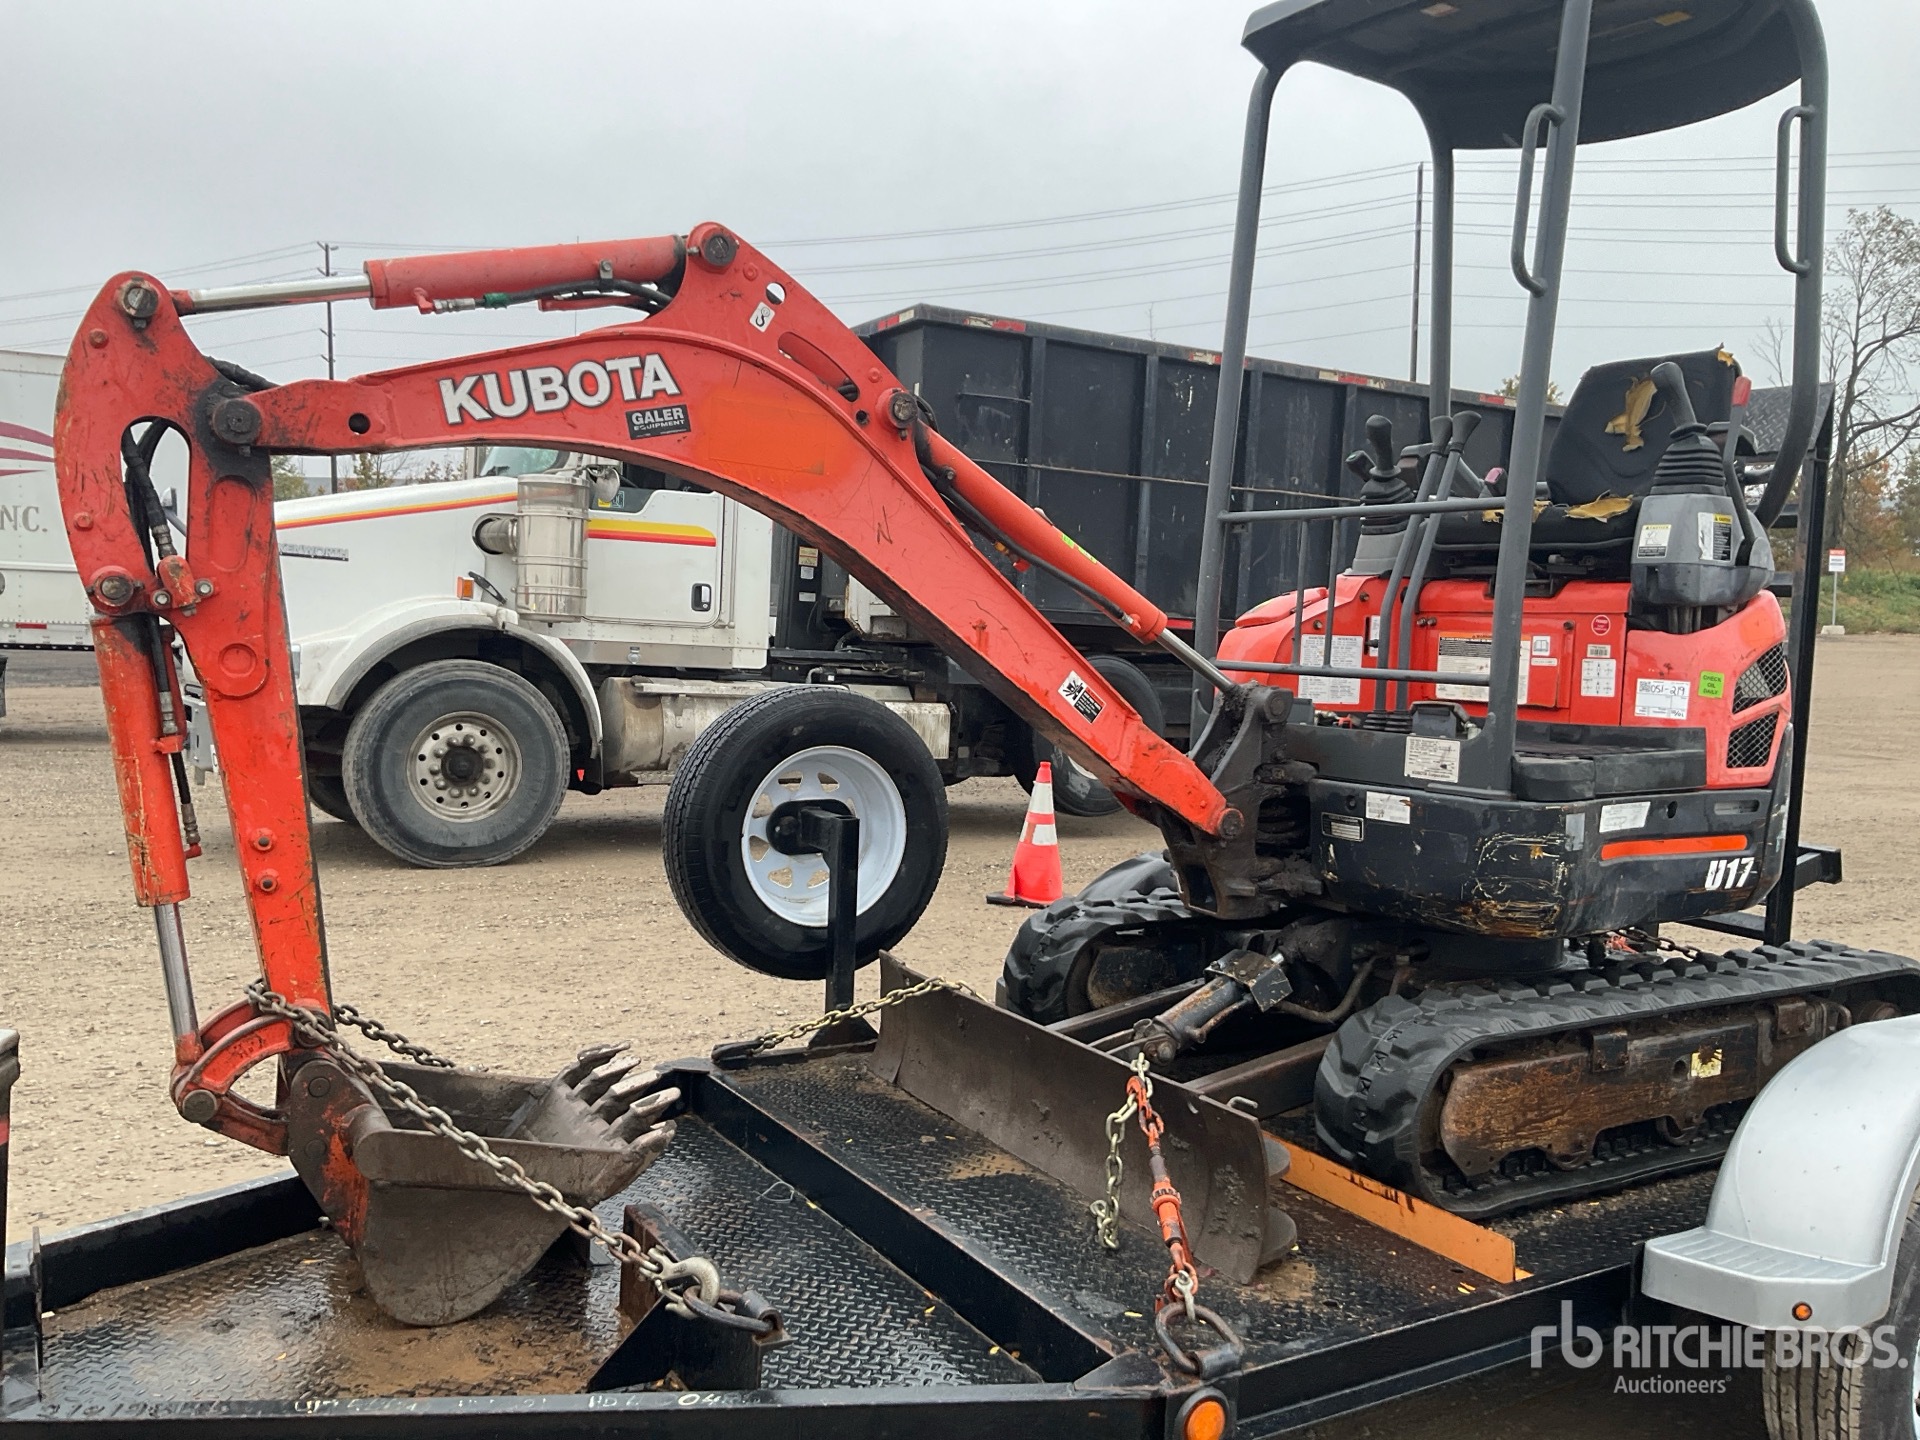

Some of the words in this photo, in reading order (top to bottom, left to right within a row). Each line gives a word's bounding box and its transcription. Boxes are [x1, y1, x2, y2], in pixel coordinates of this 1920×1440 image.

[439, 353, 681, 425] KUBOTA
[631, 407, 685, 426] GALER
[633, 419, 685, 431] EQUIPMENT
[1703, 674, 1722, 683] CHECK
[1704, 857, 1755, 891] U17
